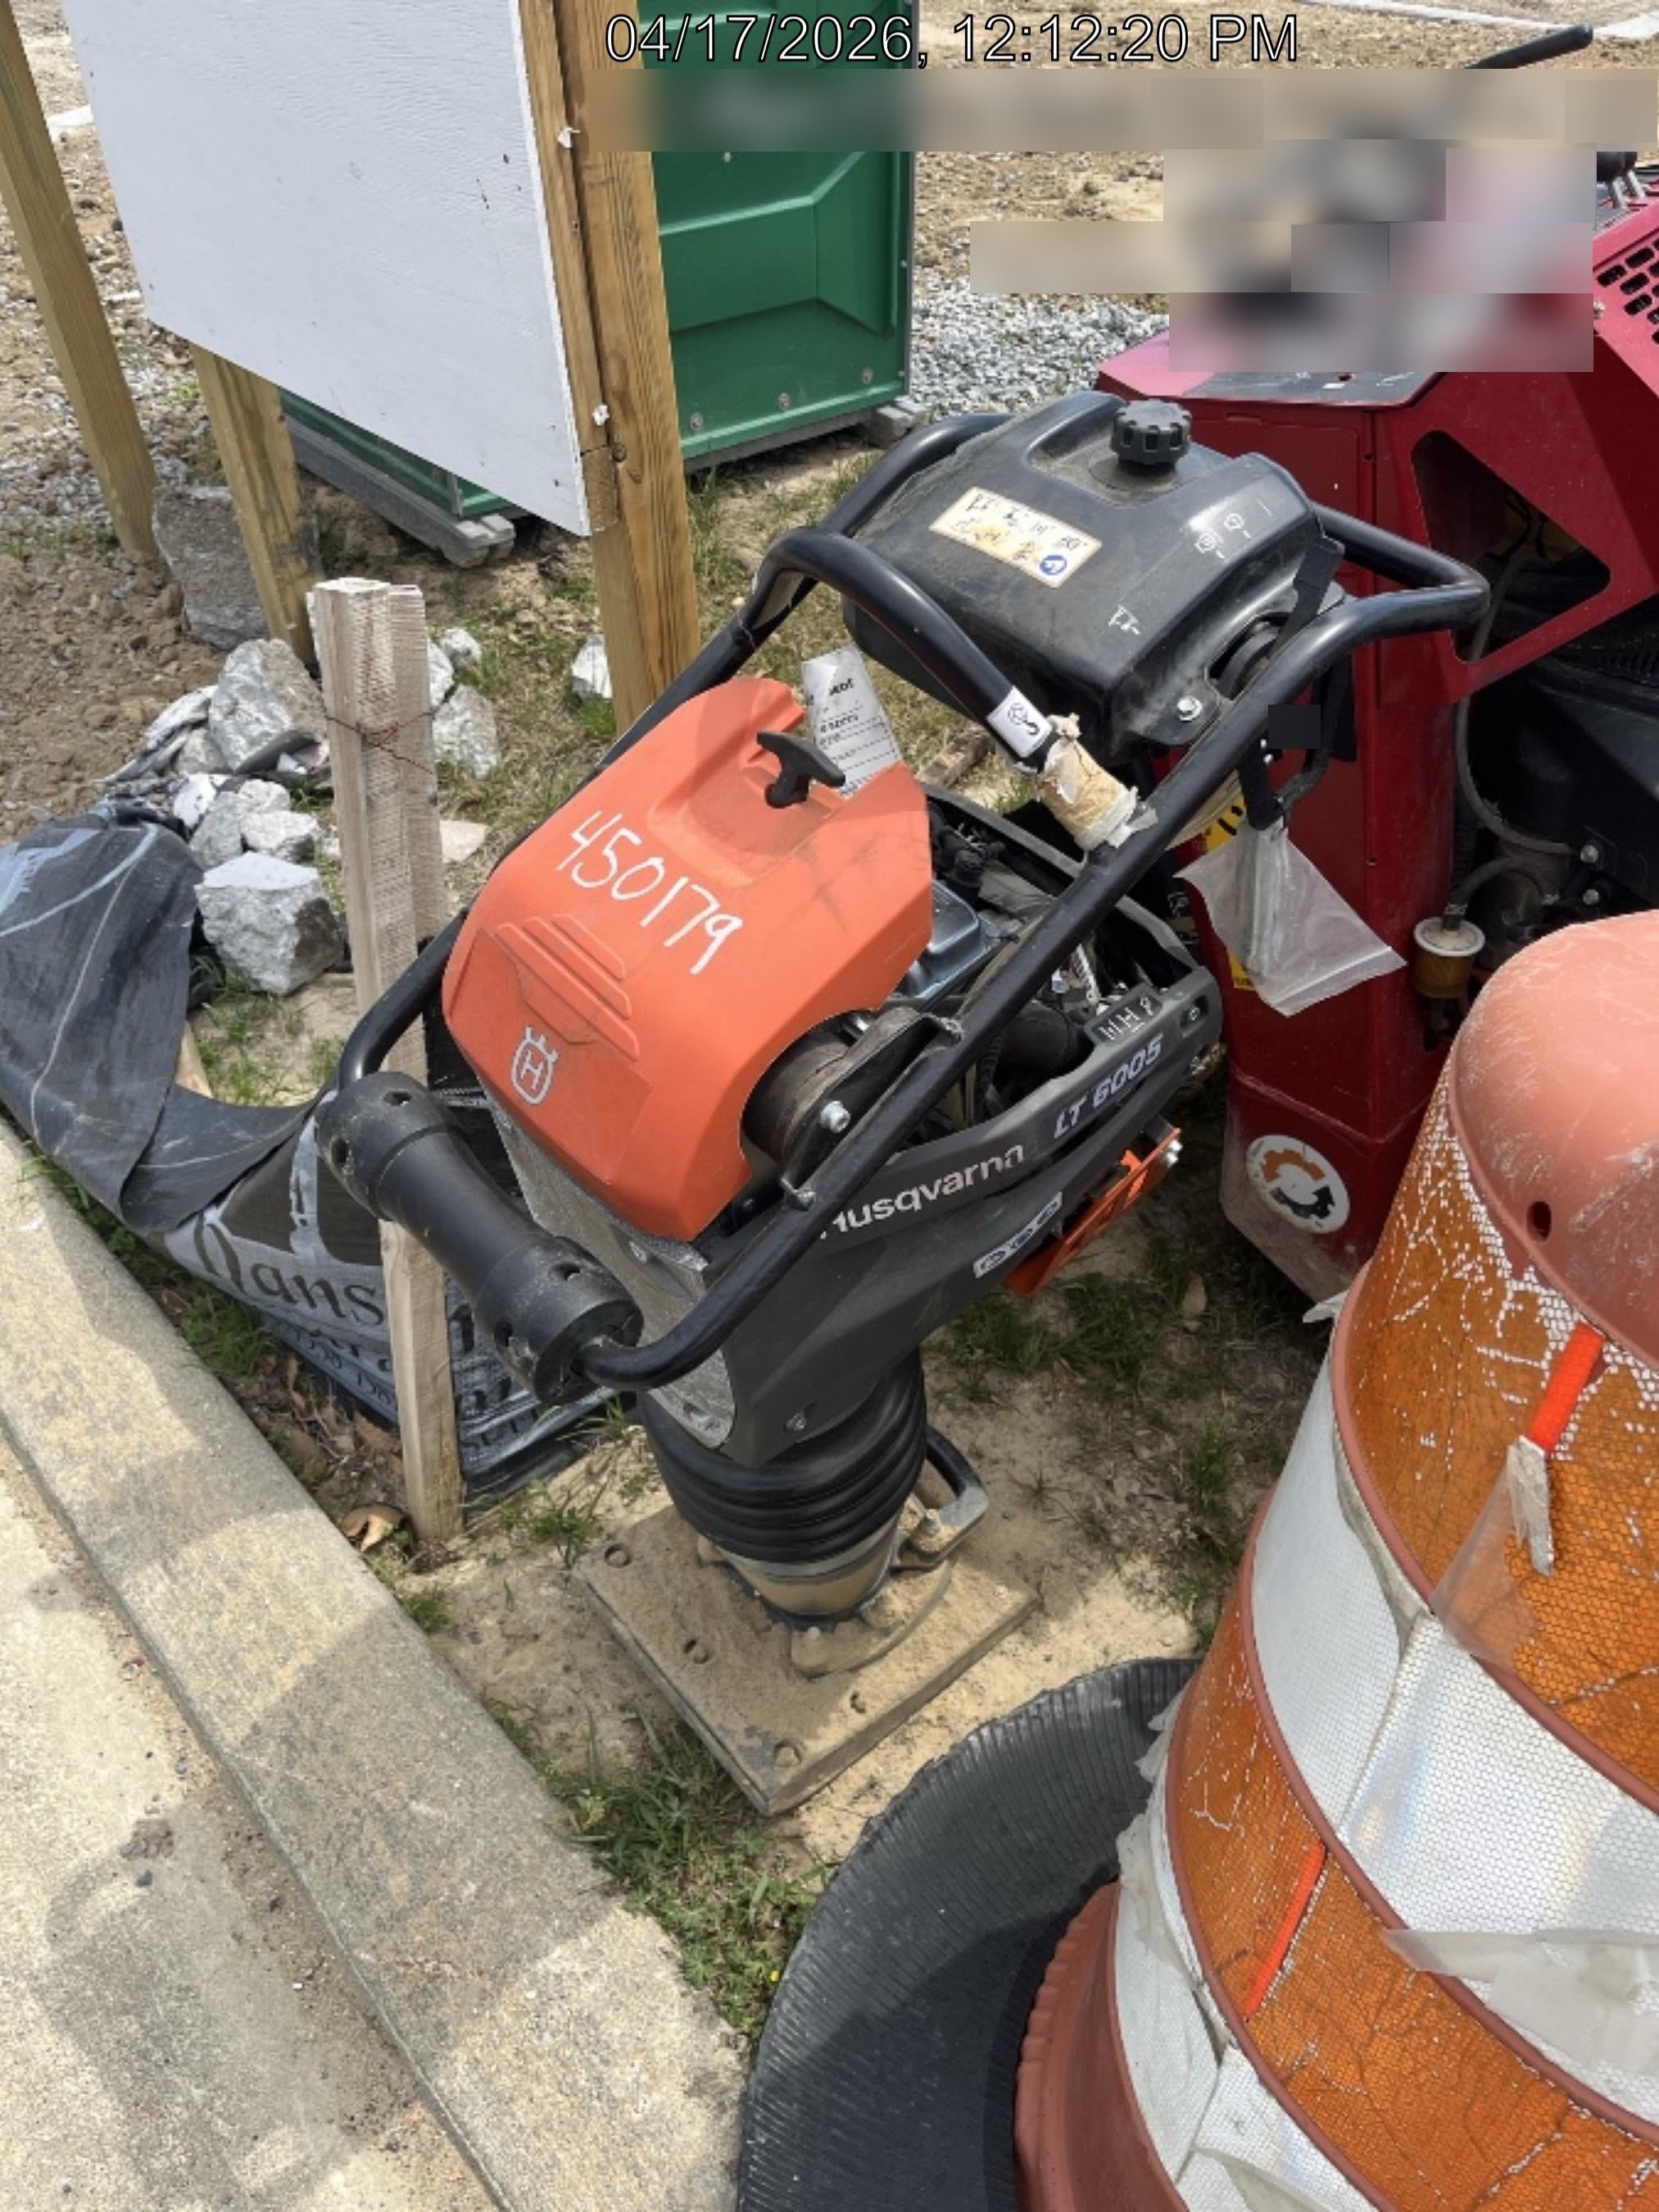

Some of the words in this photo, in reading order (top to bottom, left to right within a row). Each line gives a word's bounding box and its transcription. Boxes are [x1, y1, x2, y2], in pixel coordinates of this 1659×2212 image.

[555, 810, 744, 975] 450179
[1054, 1093, 1088, 1139] LT
[1094, 1032, 1163, 1108] 6005
